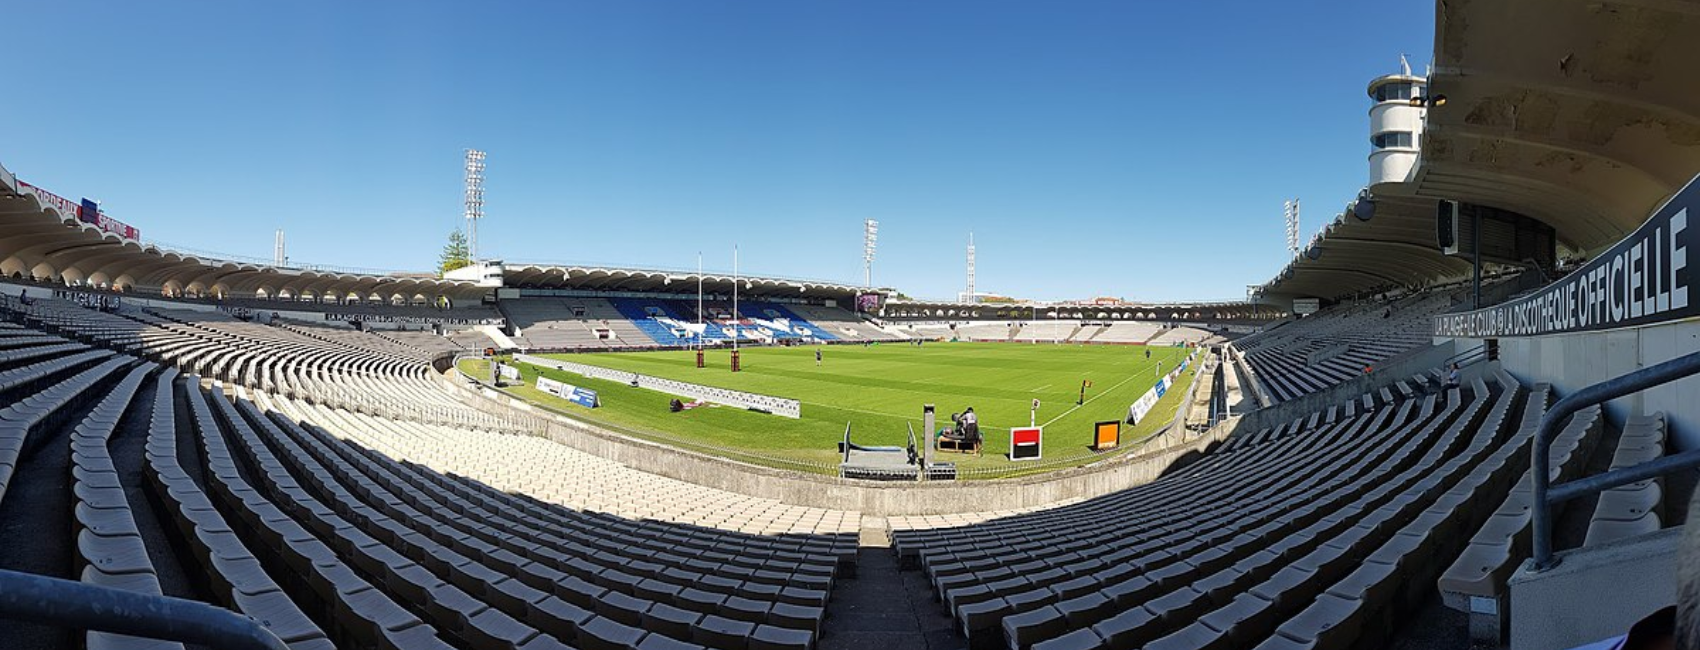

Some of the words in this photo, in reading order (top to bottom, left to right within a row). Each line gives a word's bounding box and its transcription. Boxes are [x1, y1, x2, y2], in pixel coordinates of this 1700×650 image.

[1435, 317, 1442, 336] LA
[1476, 311, 1497, 336] CLUB
[1504, 307, 1514, 335] LA
[1514, 281, 1576, 334] DISCOTHEQUE
[1578, 207, 1688, 328] OFFICIELLE
